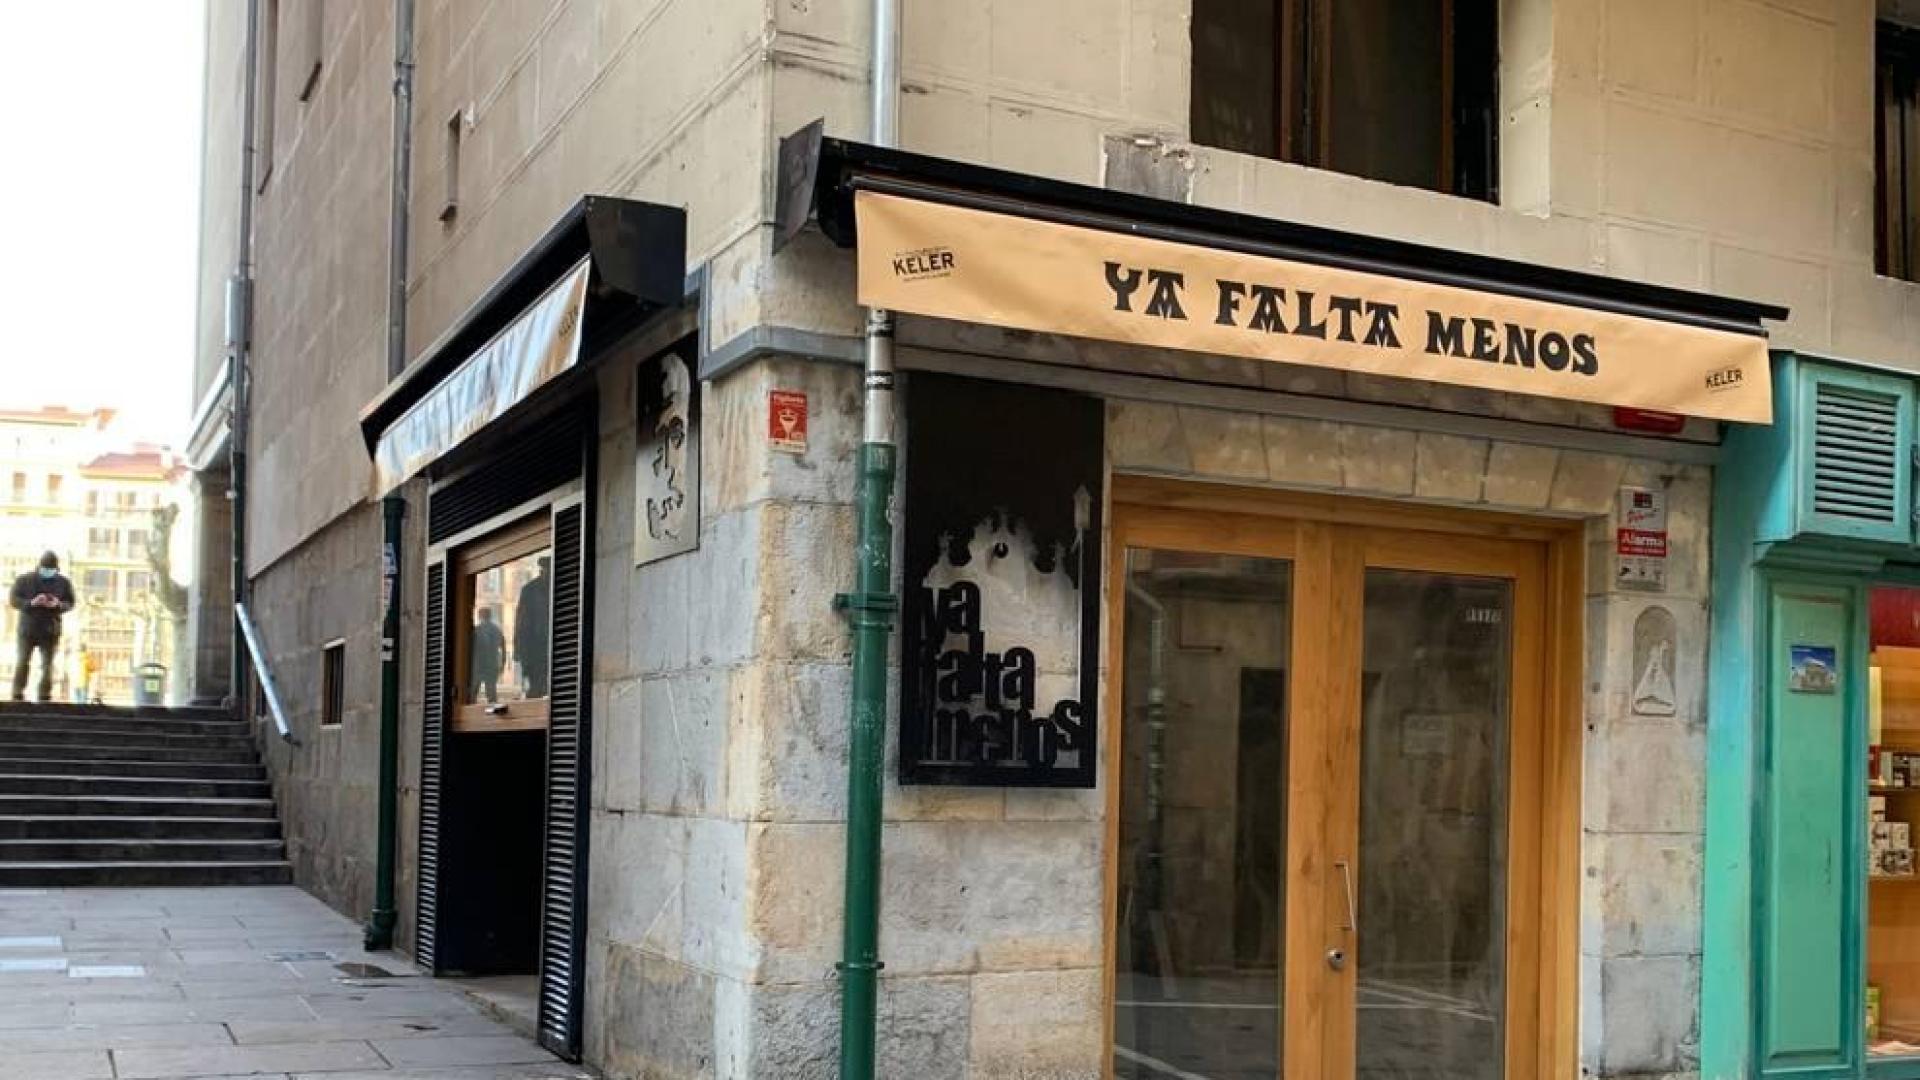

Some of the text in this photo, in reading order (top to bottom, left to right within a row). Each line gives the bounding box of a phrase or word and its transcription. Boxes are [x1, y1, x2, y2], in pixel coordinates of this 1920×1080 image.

[893, 251, 955, 276] KELER
[1104, 262, 1598, 376] YA FALTA MENOS
[1705, 369, 1743, 388] KELER
